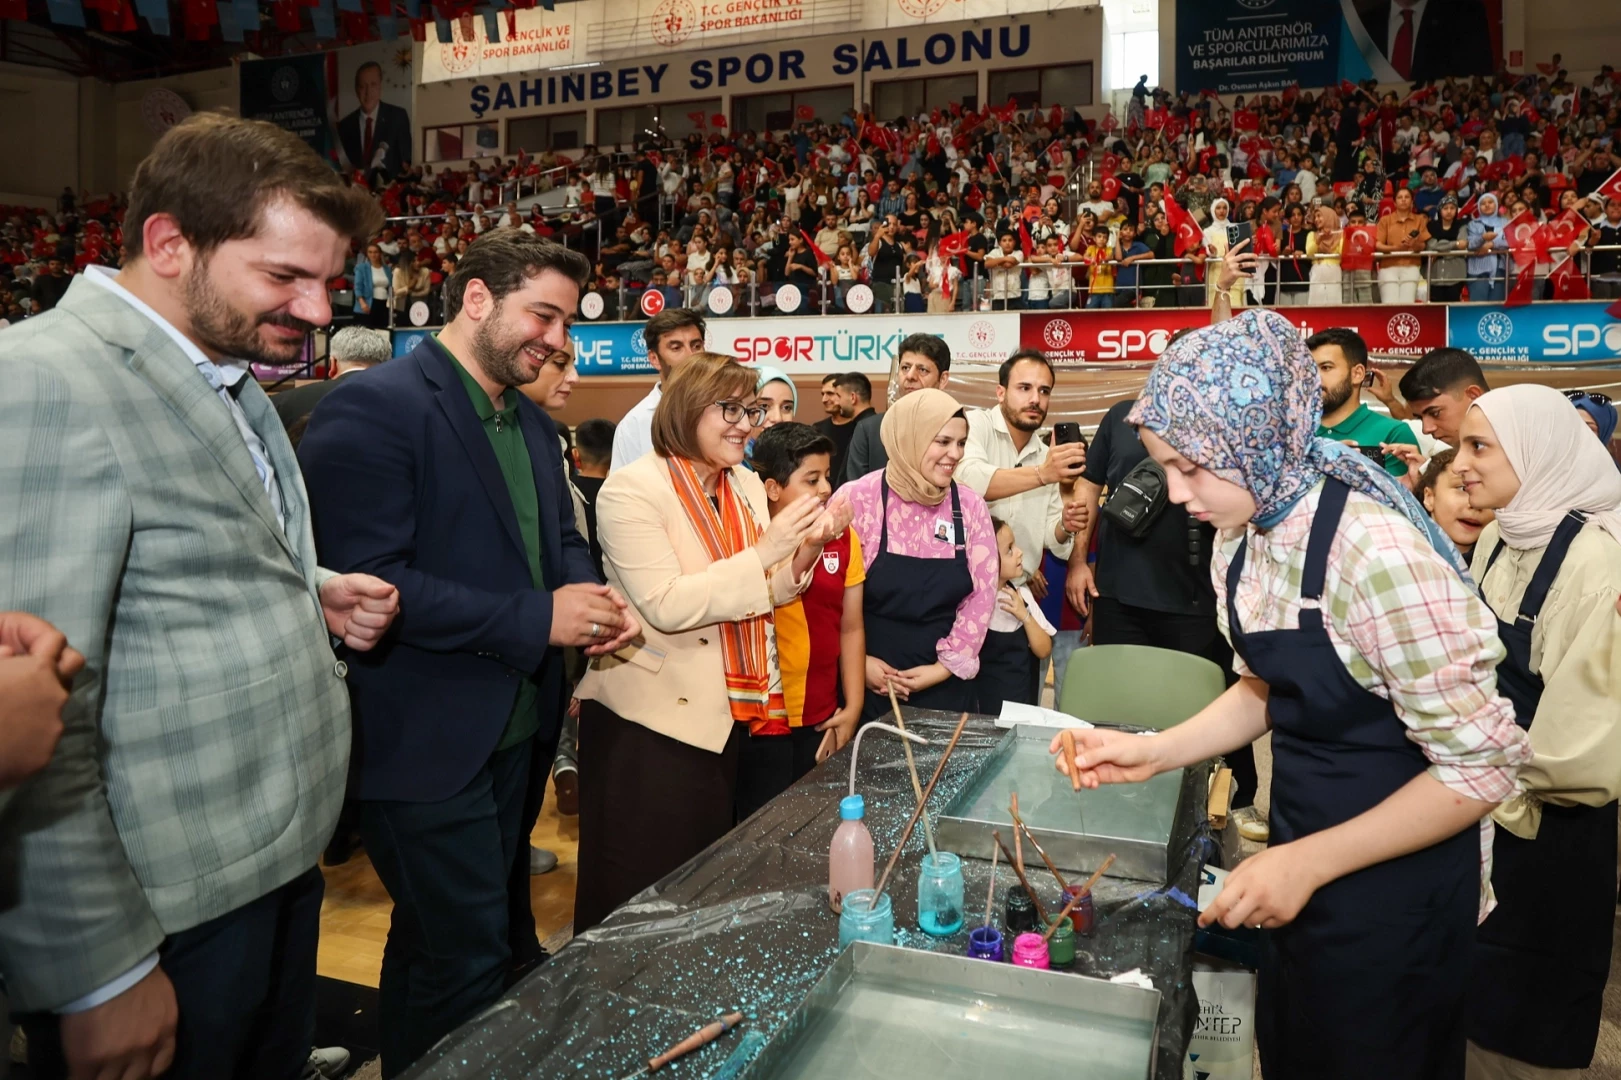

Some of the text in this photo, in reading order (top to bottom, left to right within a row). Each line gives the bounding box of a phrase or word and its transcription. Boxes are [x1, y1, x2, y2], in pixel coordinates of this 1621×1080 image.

[700, 8, 803, 32] SPOR BAKANLIĞI
[701, 5, 722, 16] T.C.
[556, 25, 570, 36] VE
[1203, 21, 1313, 42] TÜM ANTRENÖR
[483, 39, 570, 59] SPOR BAKANLIĞI
[1188, 35, 1329, 57] VE SPORCULARIMIZA
[690, 49, 806, 89] SPOR
[832, 24, 1031, 76] SALONU
[1193, 50, 1324, 71] BAŞARILAR DİLİYORUM
[1231, 82, 1257, 91] Osman
[574, 335, 613, 365] İYE
[733, 328, 944, 362] SPORTÜRK
[969, 351, 997, 359] GENÇLİK
[1388, 346, 1423, 356] GENÇLİK
[1479, 346, 1516, 356] GENÇLİK
[1517, 346, 1529, 354] VE
